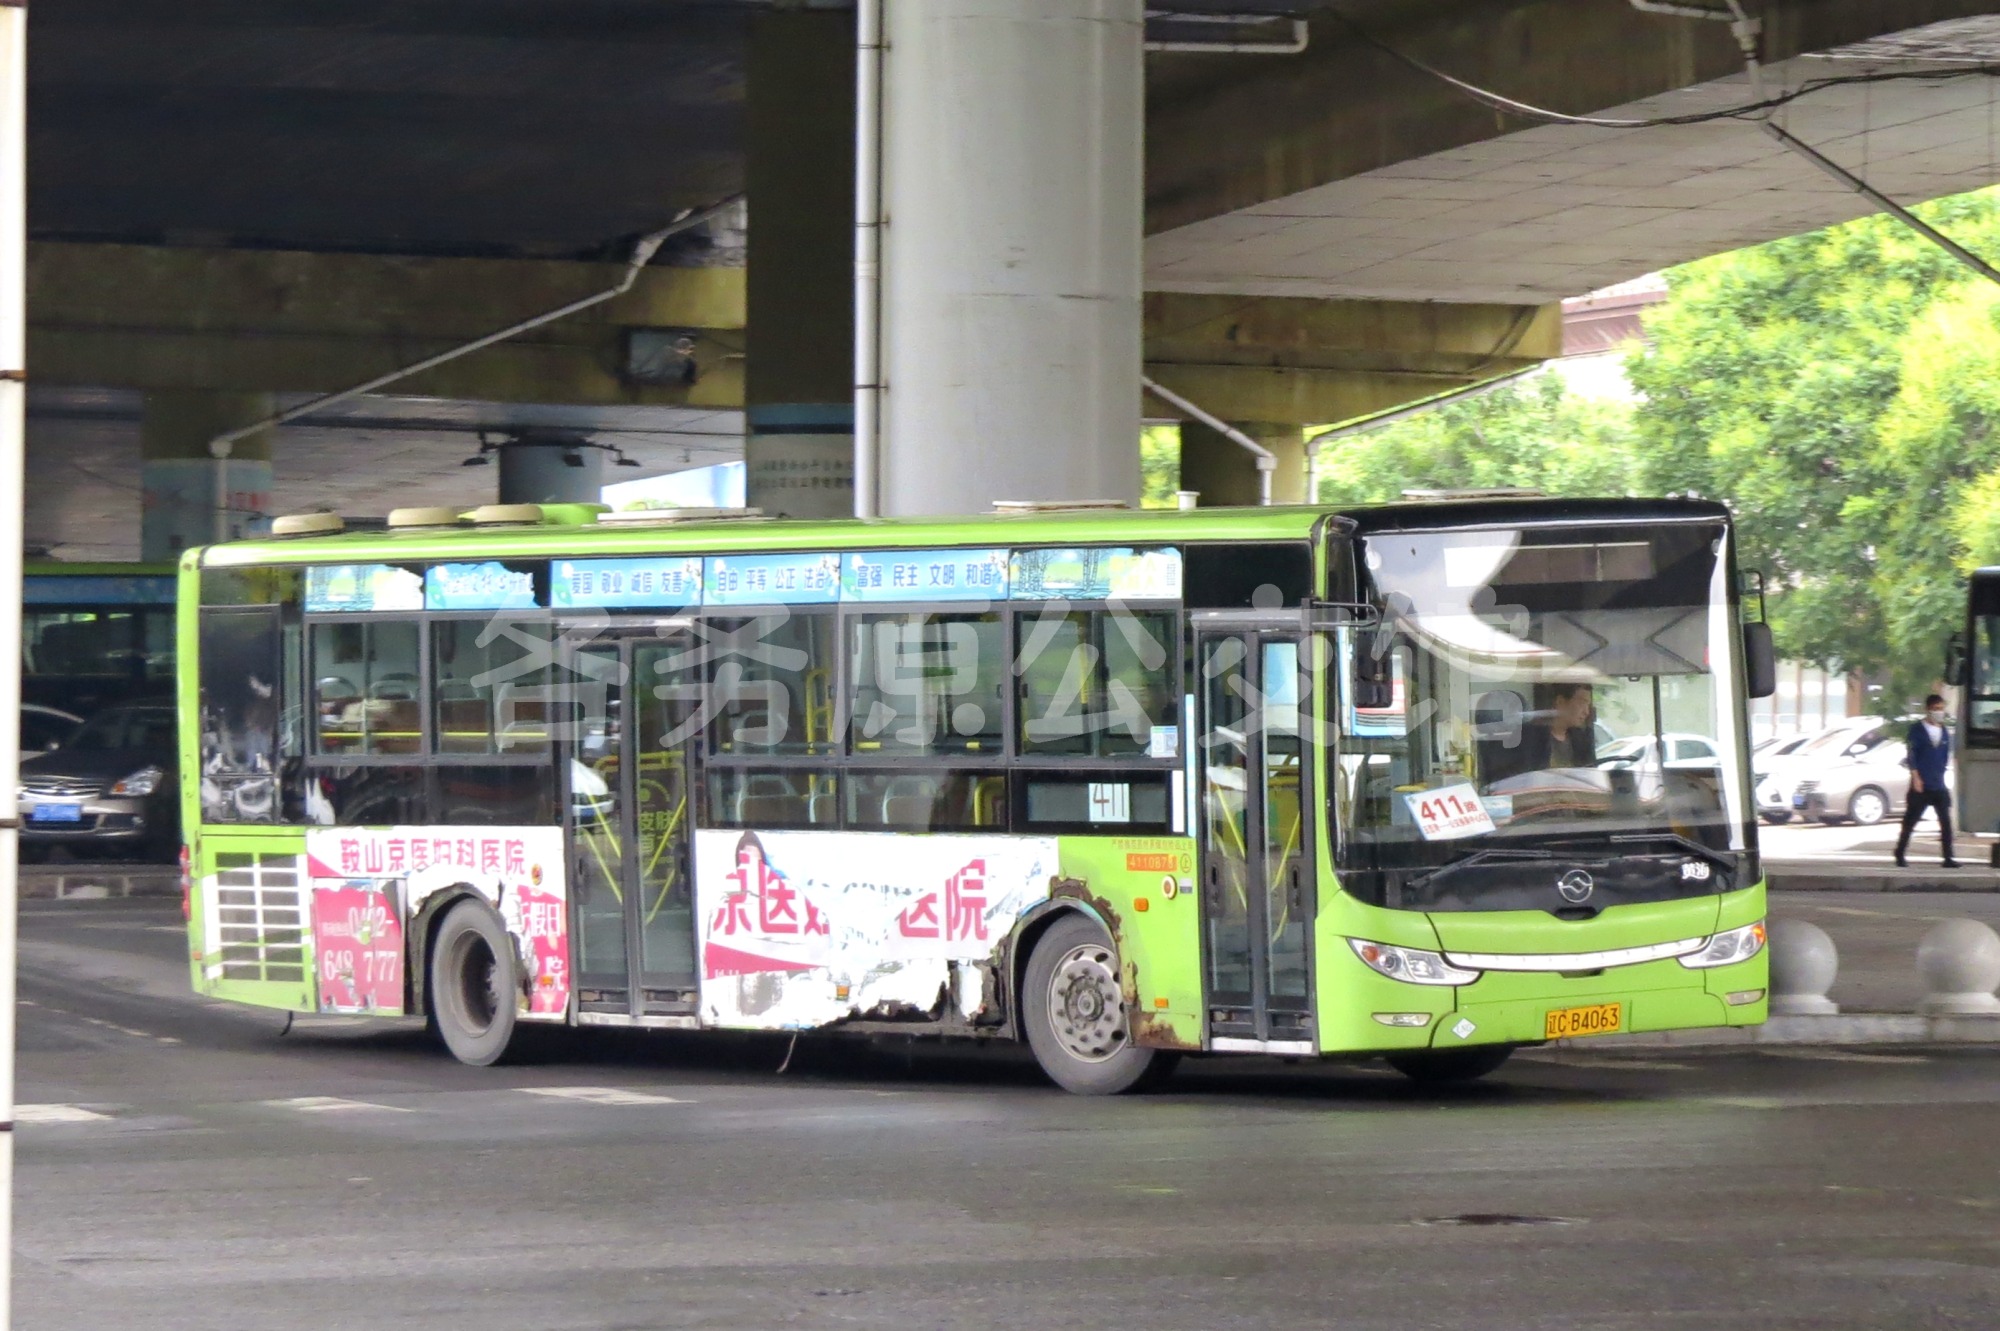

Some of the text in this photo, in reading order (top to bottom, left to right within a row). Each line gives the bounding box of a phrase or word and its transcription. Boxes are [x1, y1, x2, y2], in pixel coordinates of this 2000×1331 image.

[571, 570, 683, 595] 爱国 敬业 诚信 友善
[717, 566, 825, 592] 自由 平等 公正 法治
[858, 562, 993, 588] 富强 民主 文明 和谐
[1093, 784, 1125, 817] 411
[340, 838, 526, 876] 鞍山京医妇科医院
